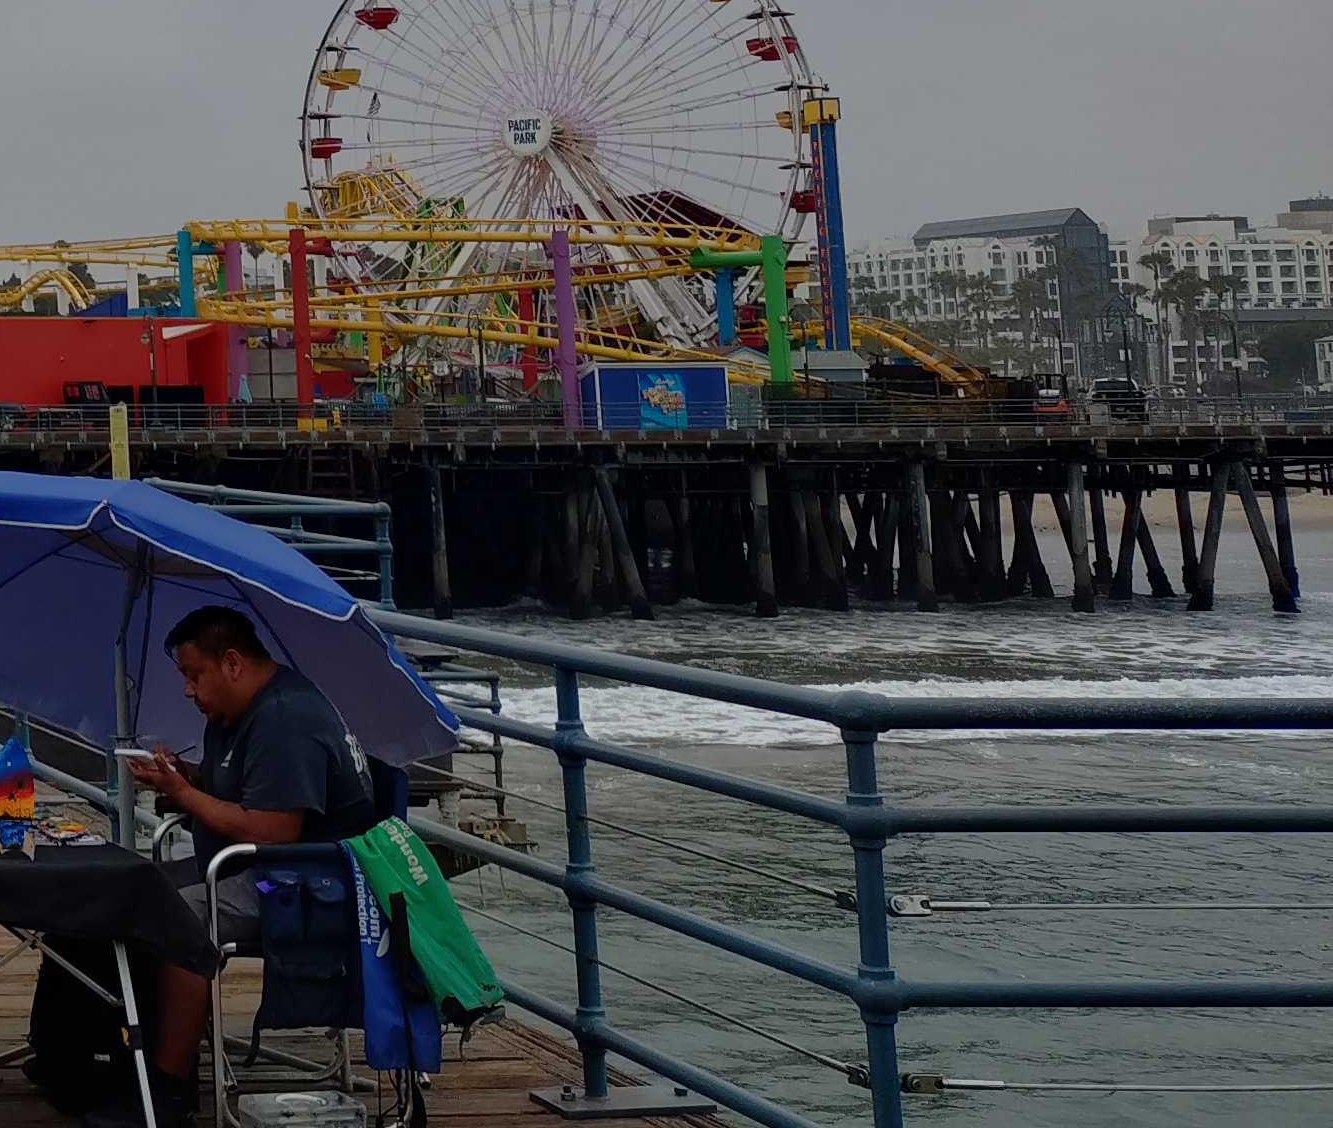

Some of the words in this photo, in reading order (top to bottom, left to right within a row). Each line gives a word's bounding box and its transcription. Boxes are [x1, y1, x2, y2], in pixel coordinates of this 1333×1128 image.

[508, 118, 541, 132] PACIFIC
[514, 132, 537, 144] PARK
[355, 873, 368, 936] Protection
